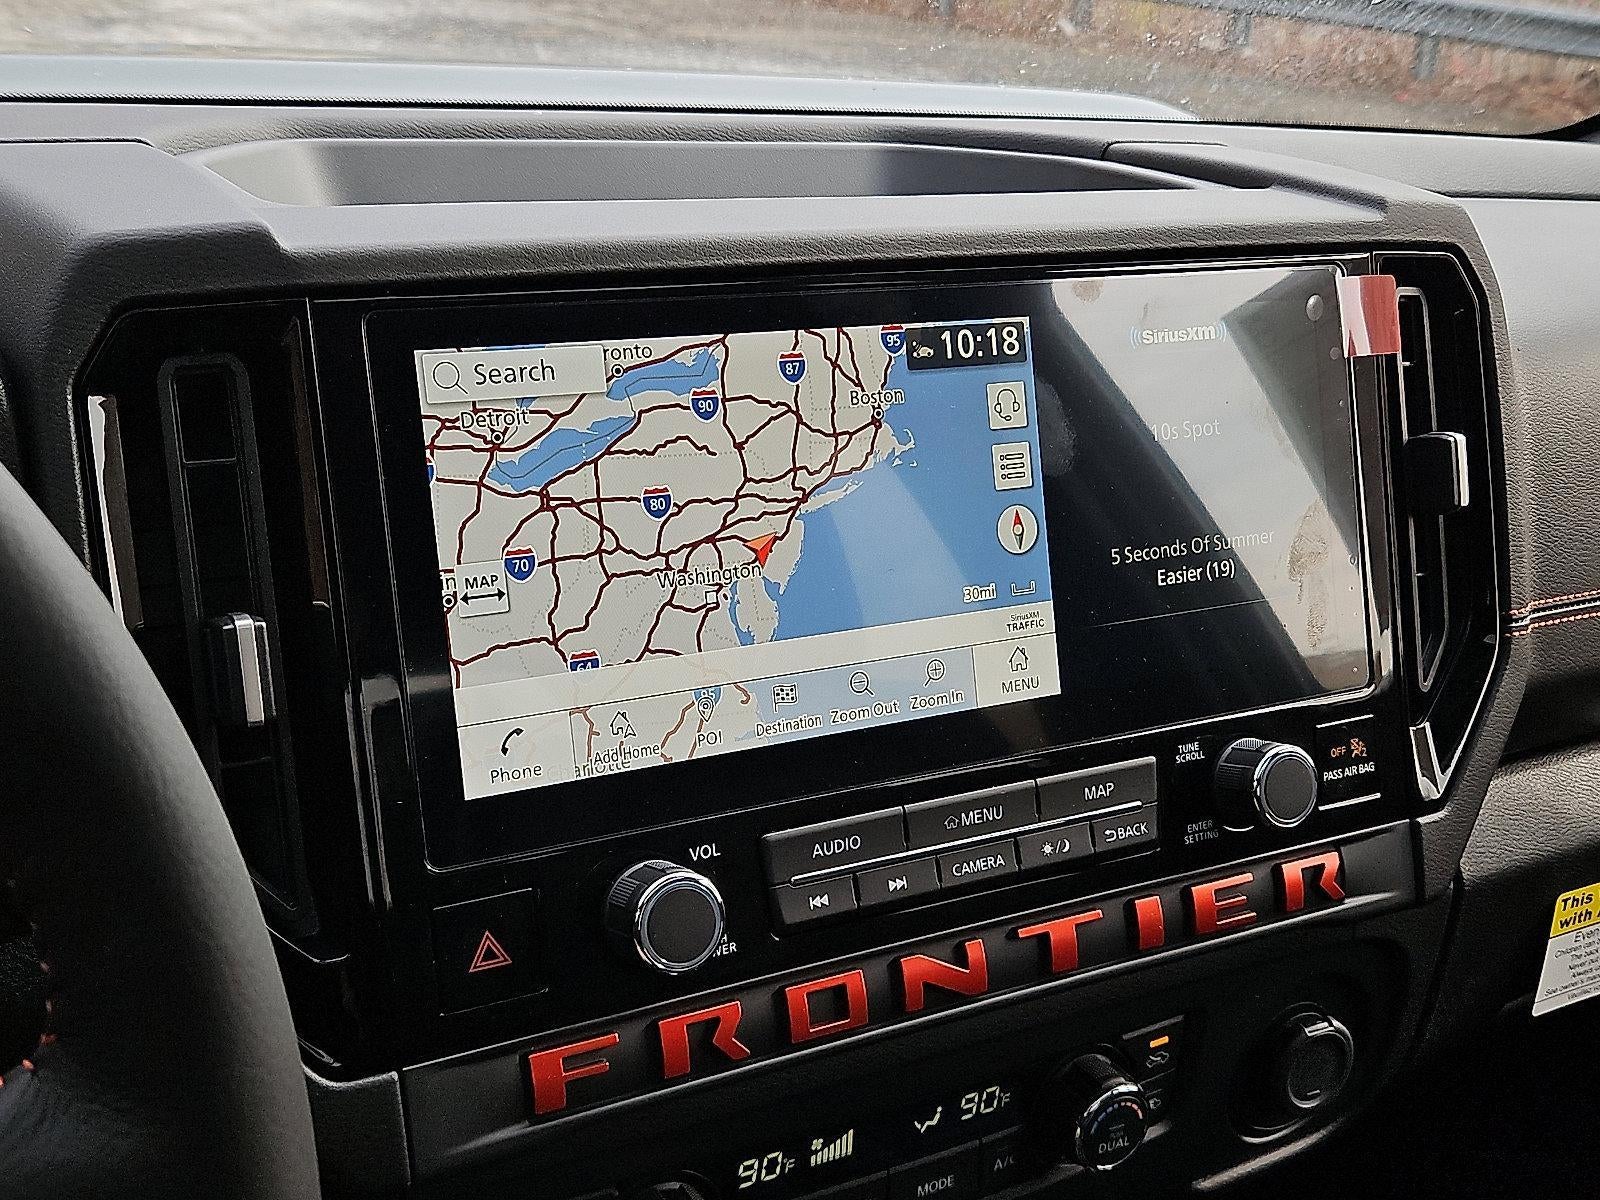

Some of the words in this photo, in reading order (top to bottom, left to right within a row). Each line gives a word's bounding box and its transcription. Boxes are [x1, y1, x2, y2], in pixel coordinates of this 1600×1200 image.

[887, 334, 900, 347] 95
[940, 326, 1020, 359] 10:18
[603, 344, 652, 361] ronto
[473, 359, 556, 386] Search
[785, 362, 800, 375] 87
[698, 399, 713, 413] 90
[850, 389, 904, 405] Boston
[461, 407, 529, 429] Detroit
[1152, 423, 1178, 441] 10s
[1183, 420, 1221, 441] Spot
[650, 497, 666, 511] 80
[1111, 548, 1120, 565] 5
[1125, 538, 1187, 562] Seconds
[1191, 536, 1211, 553] Of
[1213, 531, 1274, 551] Summer
[512, 559, 529, 573] 70
[1157, 565, 1203, 586] Easier
[1206, 559, 1235, 582] (19)
[464, 574, 499, 590] MAP
[656, 563, 762, 589] Washington
[963, 584, 996, 601] 30mi
[1006, 618, 1045, 633] TRAFFIC
[1010, 611, 1040, 622] SiriusXM
[1001, 677, 1040, 694] MENU
[910, 693, 948, 710] Zoom
[951, 690, 964, 704] In
[831, 706, 870, 724] Zoom
[874, 700, 899, 717] Out
[756, 714, 821, 737] Destination
[697, 731, 723, 747] POI
[1178, 742, 1200, 754] TUNE
[594, 750, 619, 766] Add
[624, 744, 660, 760] Home
[1175, 751, 1205, 764] SCROLL
[1331, 746, 1347, 758] OFF
[490, 764, 542, 784] Phone
[1323, 769, 1343, 782] PASS
[1344, 765, 1358, 777] AIR
[1359, 762, 1375, 773] BAG
[1084, 782, 1114, 800] MAP
[961, 806, 1003, 827] MENU
[1117, 822, 1149, 840] BACK
[1187, 820, 1213, 833] ENTER
[812, 835, 861, 858] AUDIO
[1184, 830, 1219, 845] SETTING
[689, 843, 721, 861] VOL
[952, 853, 1006, 877] CAMERA
[1561, 892, 1594, 912] This
[1559, 908, 1593, 929] with
[528, 850, 1346, 1114] FRONTIER
[1099, 1136, 1130, 1153] DUAL
[917, 1174, 955, 1197] MODE
